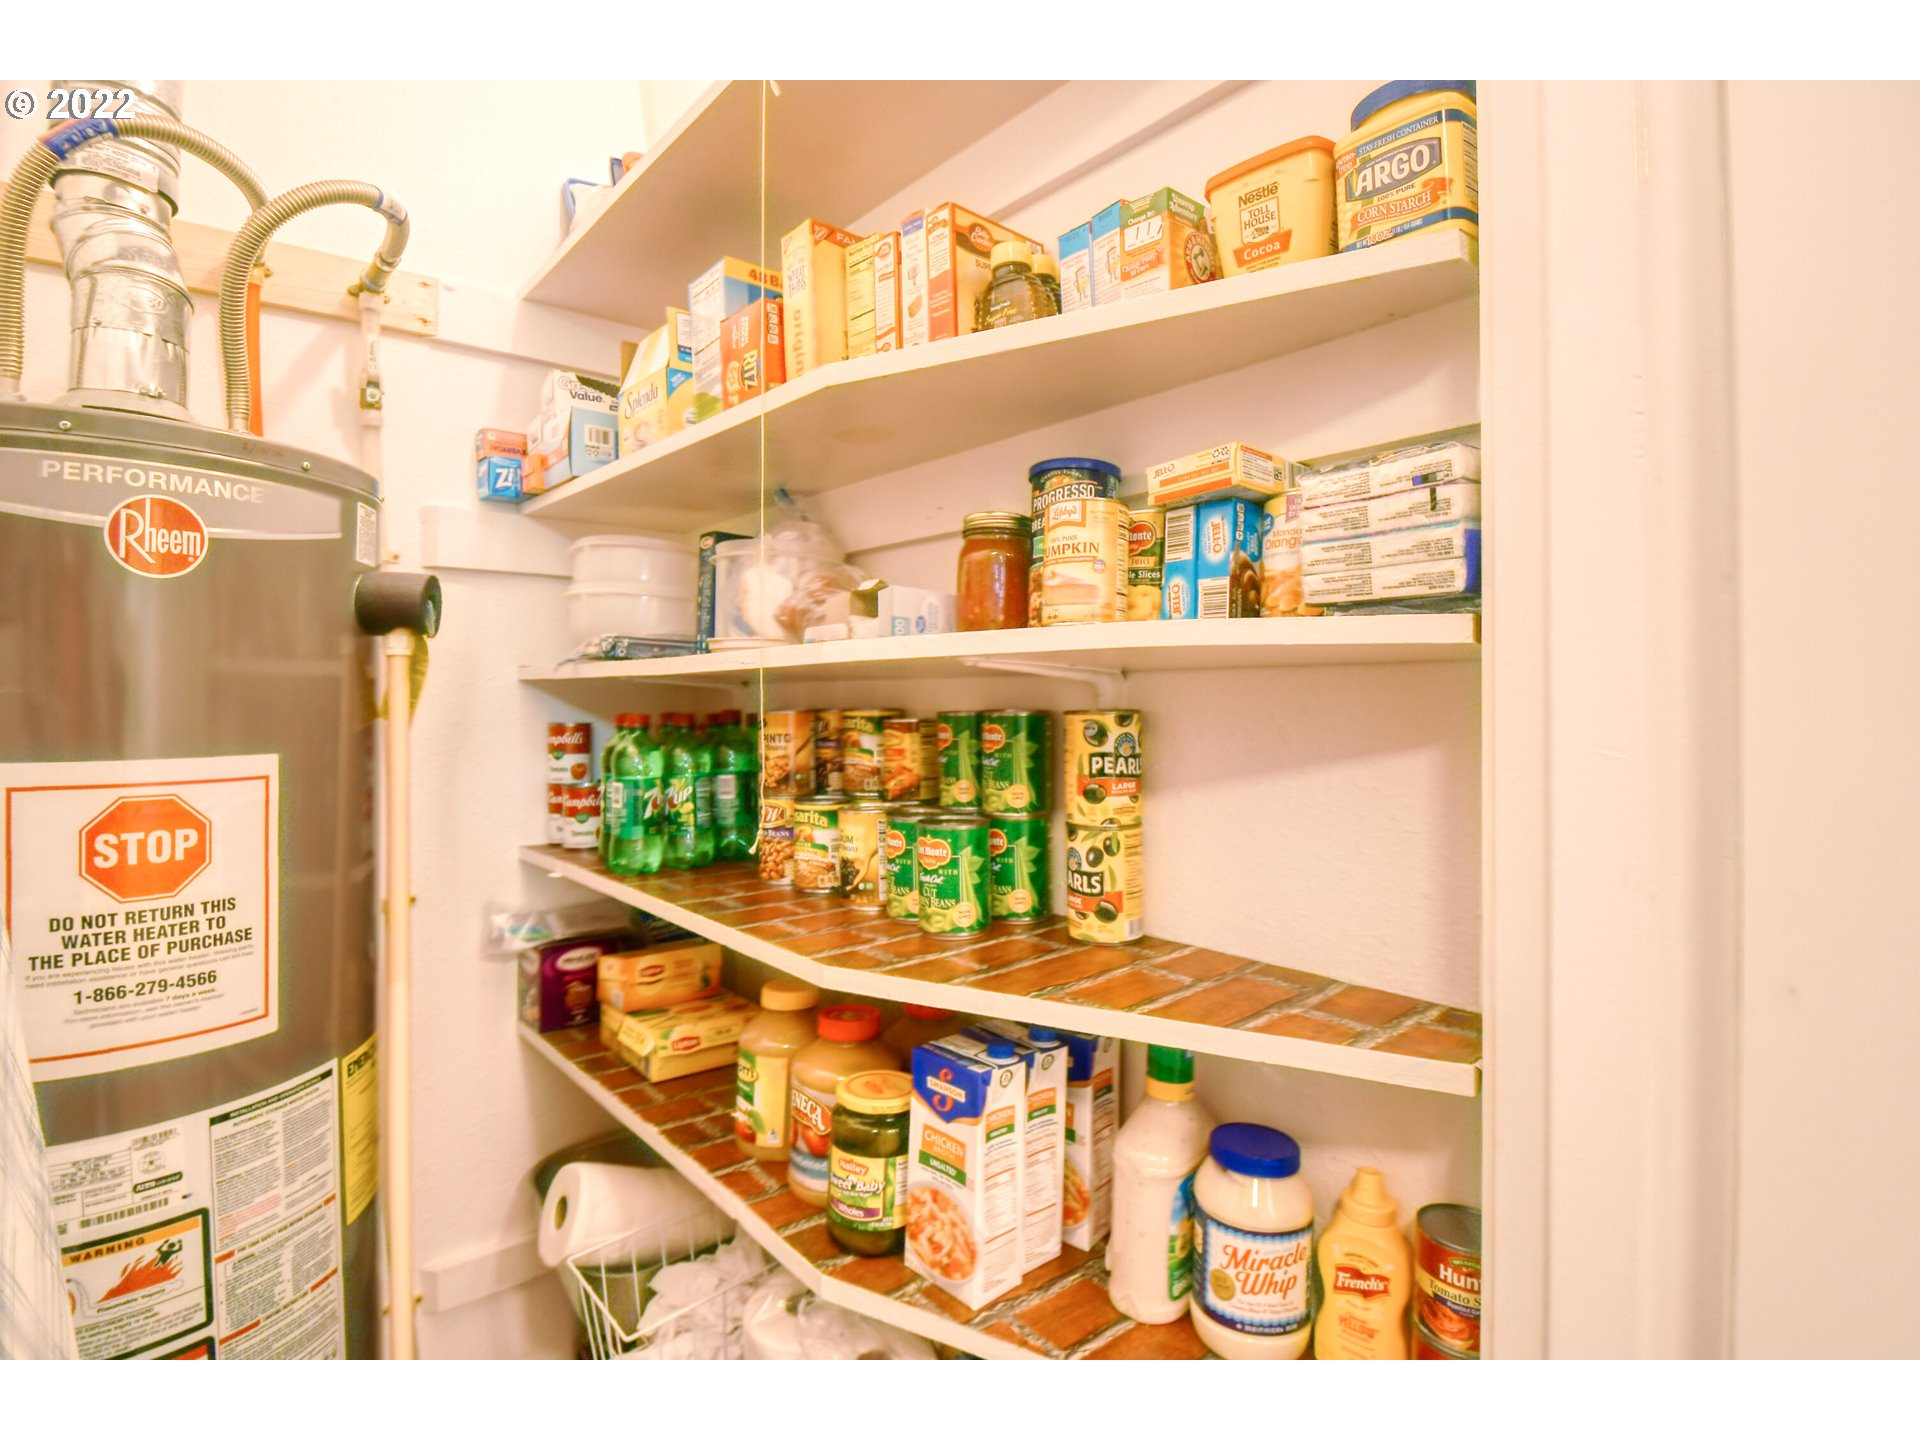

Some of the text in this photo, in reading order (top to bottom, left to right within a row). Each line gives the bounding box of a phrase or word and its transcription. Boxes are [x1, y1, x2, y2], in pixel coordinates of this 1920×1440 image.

[1396, 116, 1439, 138] CONTAINER
[1355, 144, 1430, 196] ARGO
[1396, 183, 1417, 195] PURE
[1248, 204, 1271, 219] TOLL
[1357, 190, 1432, 223] CORN STARCH
[1243, 211, 1276, 230] HOUSE
[1243, 241, 1280, 260] Cocoa
[743, 349, 758, 390] RITZ
[570, 391, 603, 403] Value
[624, 382, 659, 420] Splenda
[42, 460, 265, 503] PERFORMANCE
[1033, 484, 1095, 512] PROGRESSO
[1051, 505, 1078, 520] Libby's
[119, 498, 201, 563] Rheem
[1137, 570, 1161, 579] Slices
[1112, 782, 1136, 790] LARGE
[93, 828, 198, 868] STOP
[925, 846, 948, 857] Monte
[50, 897, 236, 933] DO NOT RETURN THIS
[930, 896, 956, 908] BEANS
[62, 916, 226, 950] WATER HEATER TO
[28, 928, 252, 971] THE PLACE OF PURCHASE
[73, 970, 217, 1004] 1-866-279-4566
[924, 1130, 965, 1158] CHICKEN
[856, 1180, 886, 1194] Baby
[838, 1204, 864, 1217] Wholes
[70, 1237, 145, 1263] WARNING
[1220, 1242, 1307, 1272] Miracle
[1235, 1270, 1297, 1300] Whip
[1336, 1270, 1385, 1291] French's
[1429, 1279, 1470, 1305] Tomato
